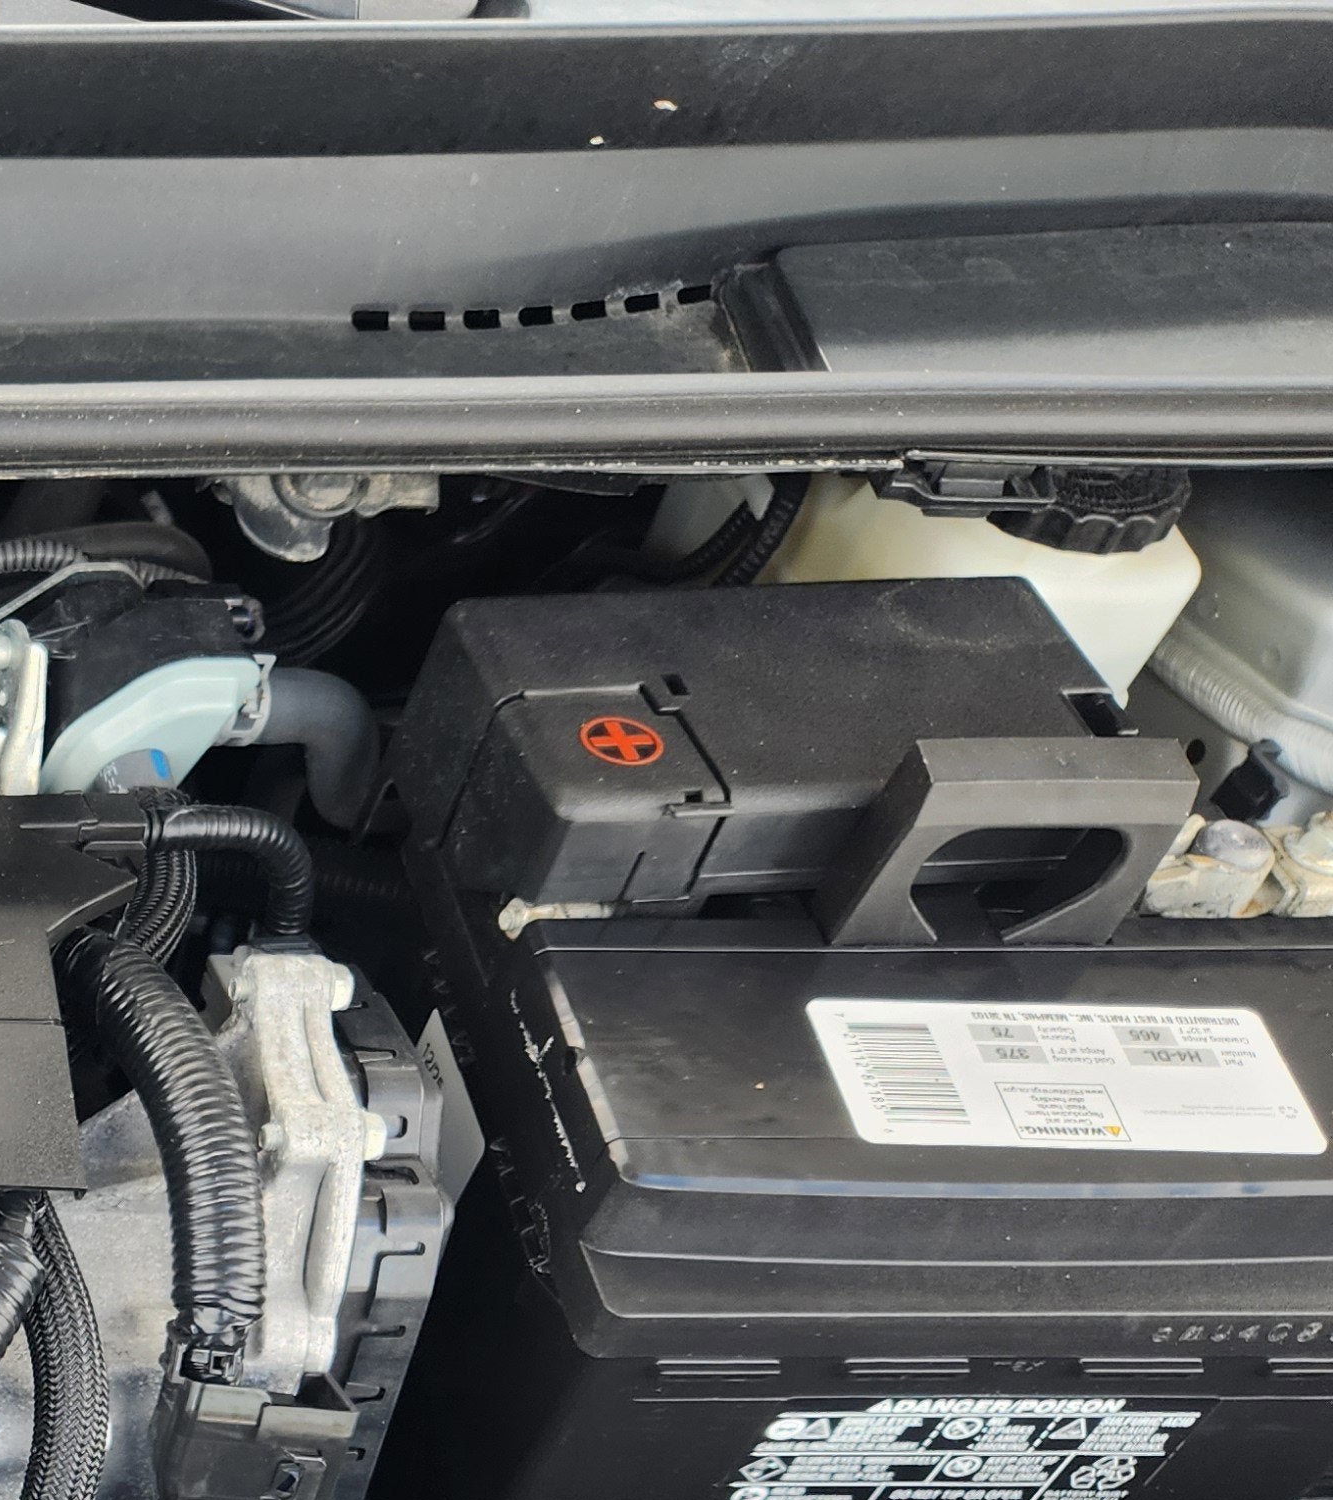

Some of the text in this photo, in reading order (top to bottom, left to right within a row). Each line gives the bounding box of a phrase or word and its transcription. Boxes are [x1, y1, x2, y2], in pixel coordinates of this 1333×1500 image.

[1175, 1015, 1239, 1026] DISTRIBUTED
[991, 1027, 1014, 1038] 75
[1128, 1028, 1161, 1042] 465
[995, 1047, 1029, 1060] 375
[1143, 1049, 1202, 1062] H4-DL
[891, 1398, 1127, 1414] DANGER/POISON
